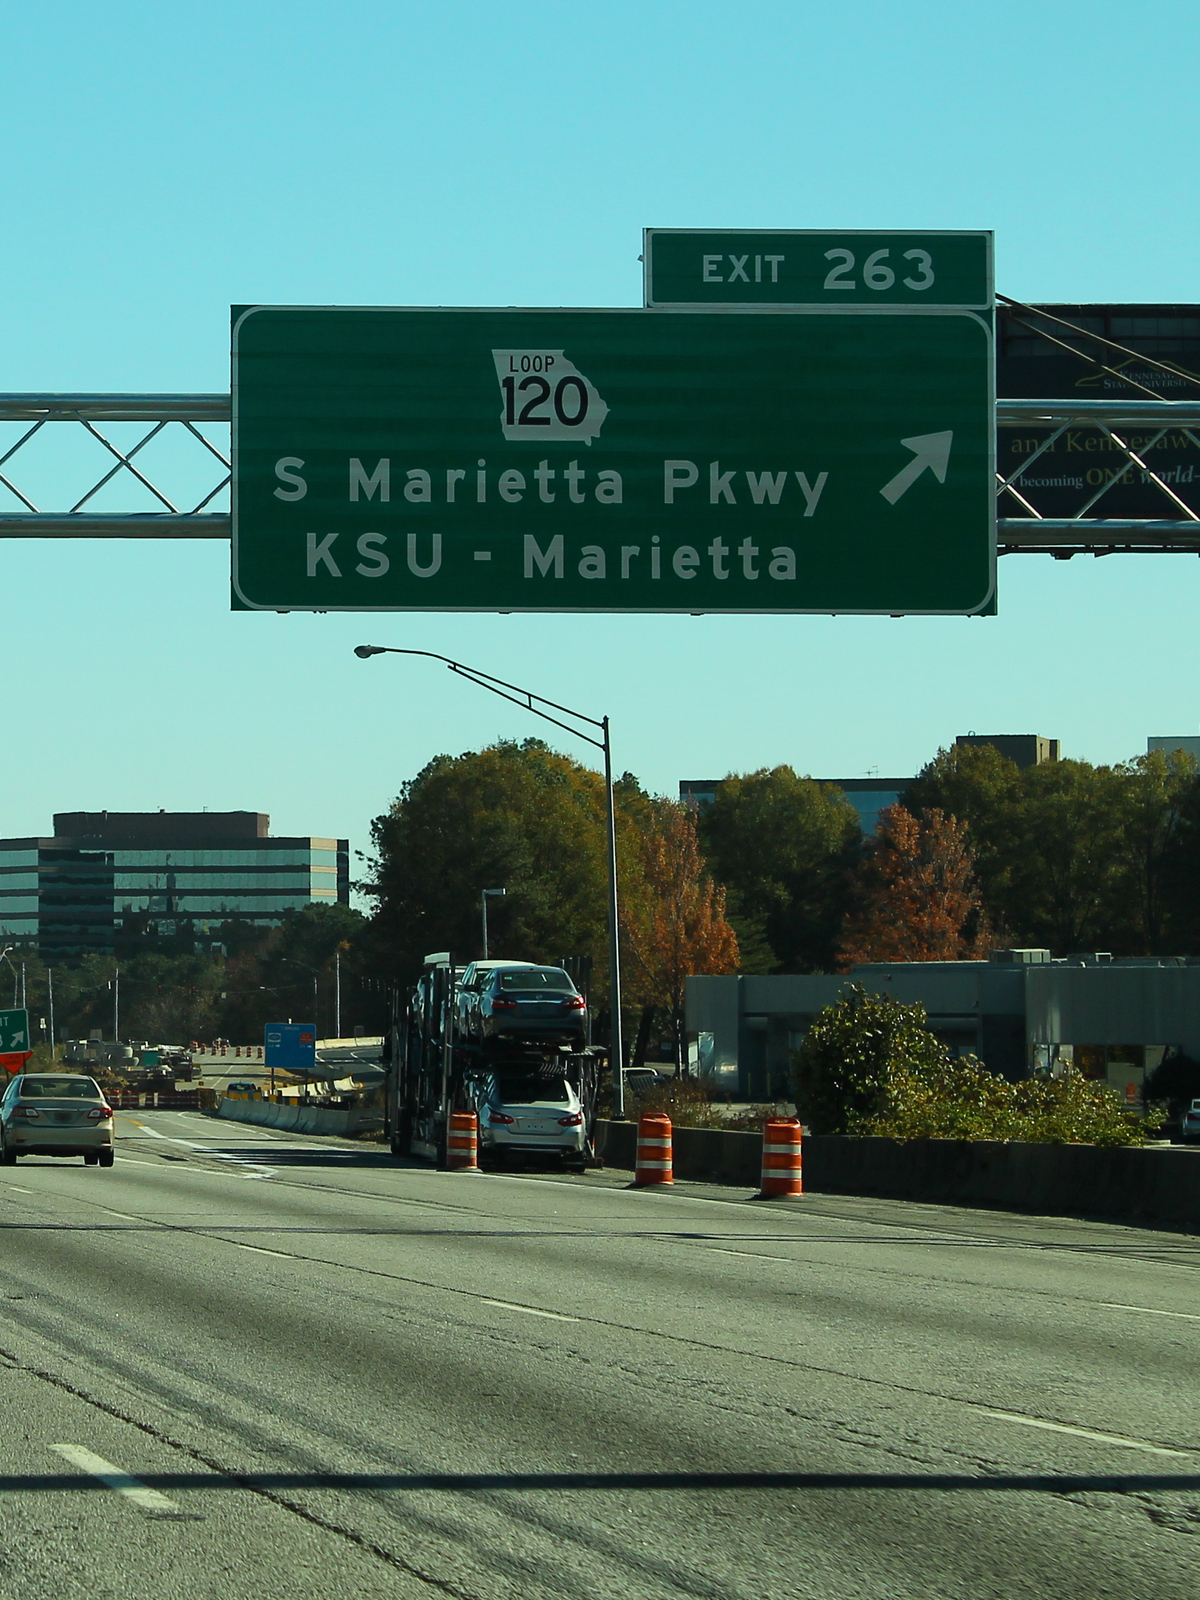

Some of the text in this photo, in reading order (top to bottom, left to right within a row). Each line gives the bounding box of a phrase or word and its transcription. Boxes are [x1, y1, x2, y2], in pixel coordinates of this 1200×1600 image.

[702, 248, 935, 291] EXIT 263
[509, 355, 555, 373] LOOP
[502, 375, 589, 427] 120
[1066, 431, 1191, 452] Kennesaw
[273, 456, 829, 517] S Marietta Pkwy
[1019, 475, 1084, 489] becoming
[1086, 467, 1135, 486] ONE
[306, 532, 442, 578] KSU
[523, 533, 797, 580] Marietta
